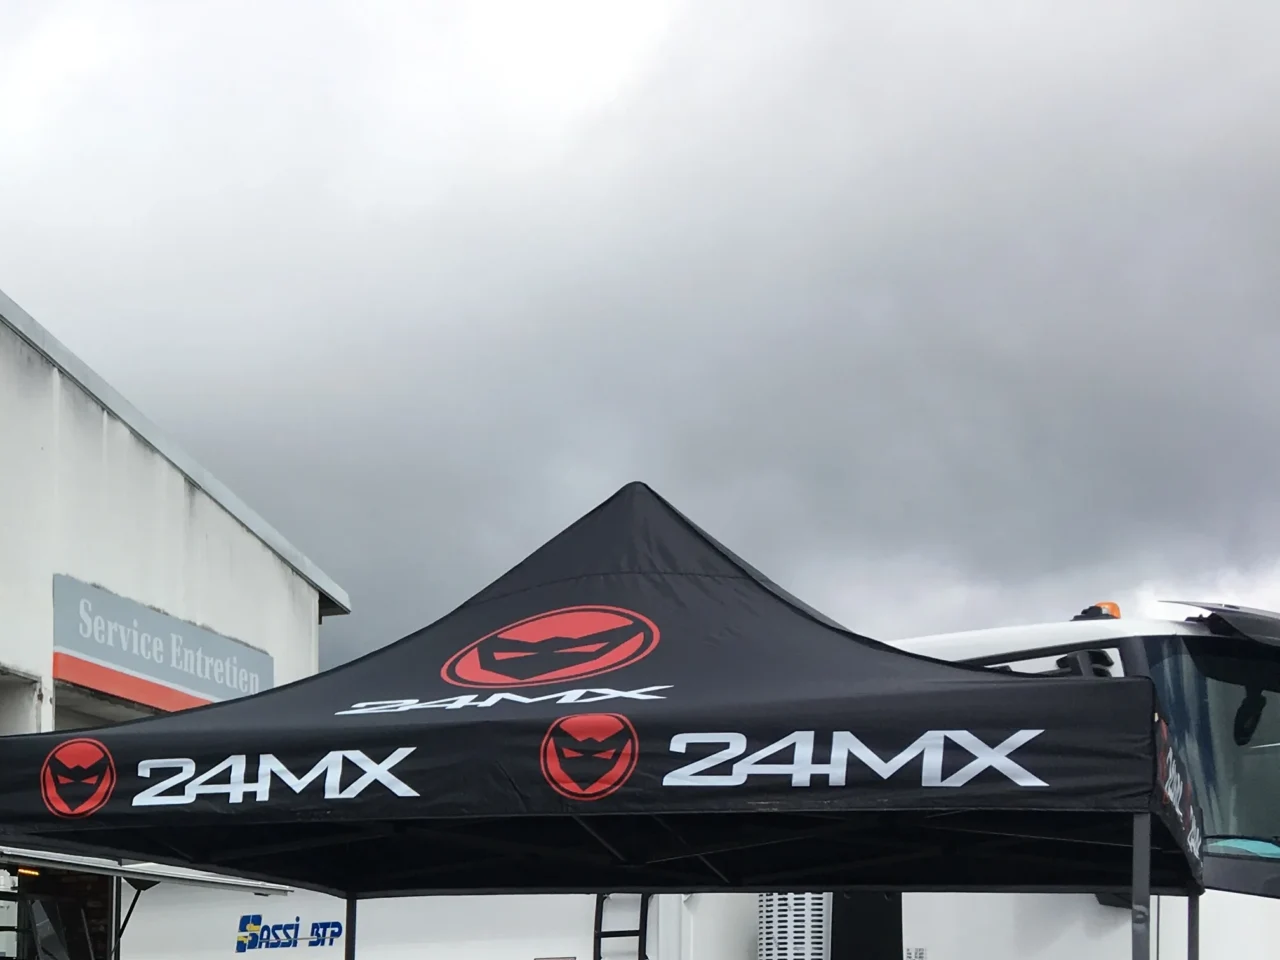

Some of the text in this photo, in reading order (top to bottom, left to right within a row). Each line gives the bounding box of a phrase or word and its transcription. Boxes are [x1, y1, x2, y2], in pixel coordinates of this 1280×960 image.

[79, 598, 260, 695] Service Entretien
[334, 684, 675, 716] 24MX
[131, 746, 422, 807] 24MX
[661, 728, 1051, 788] 24MX
[308, 921, 343, 947] BTP
